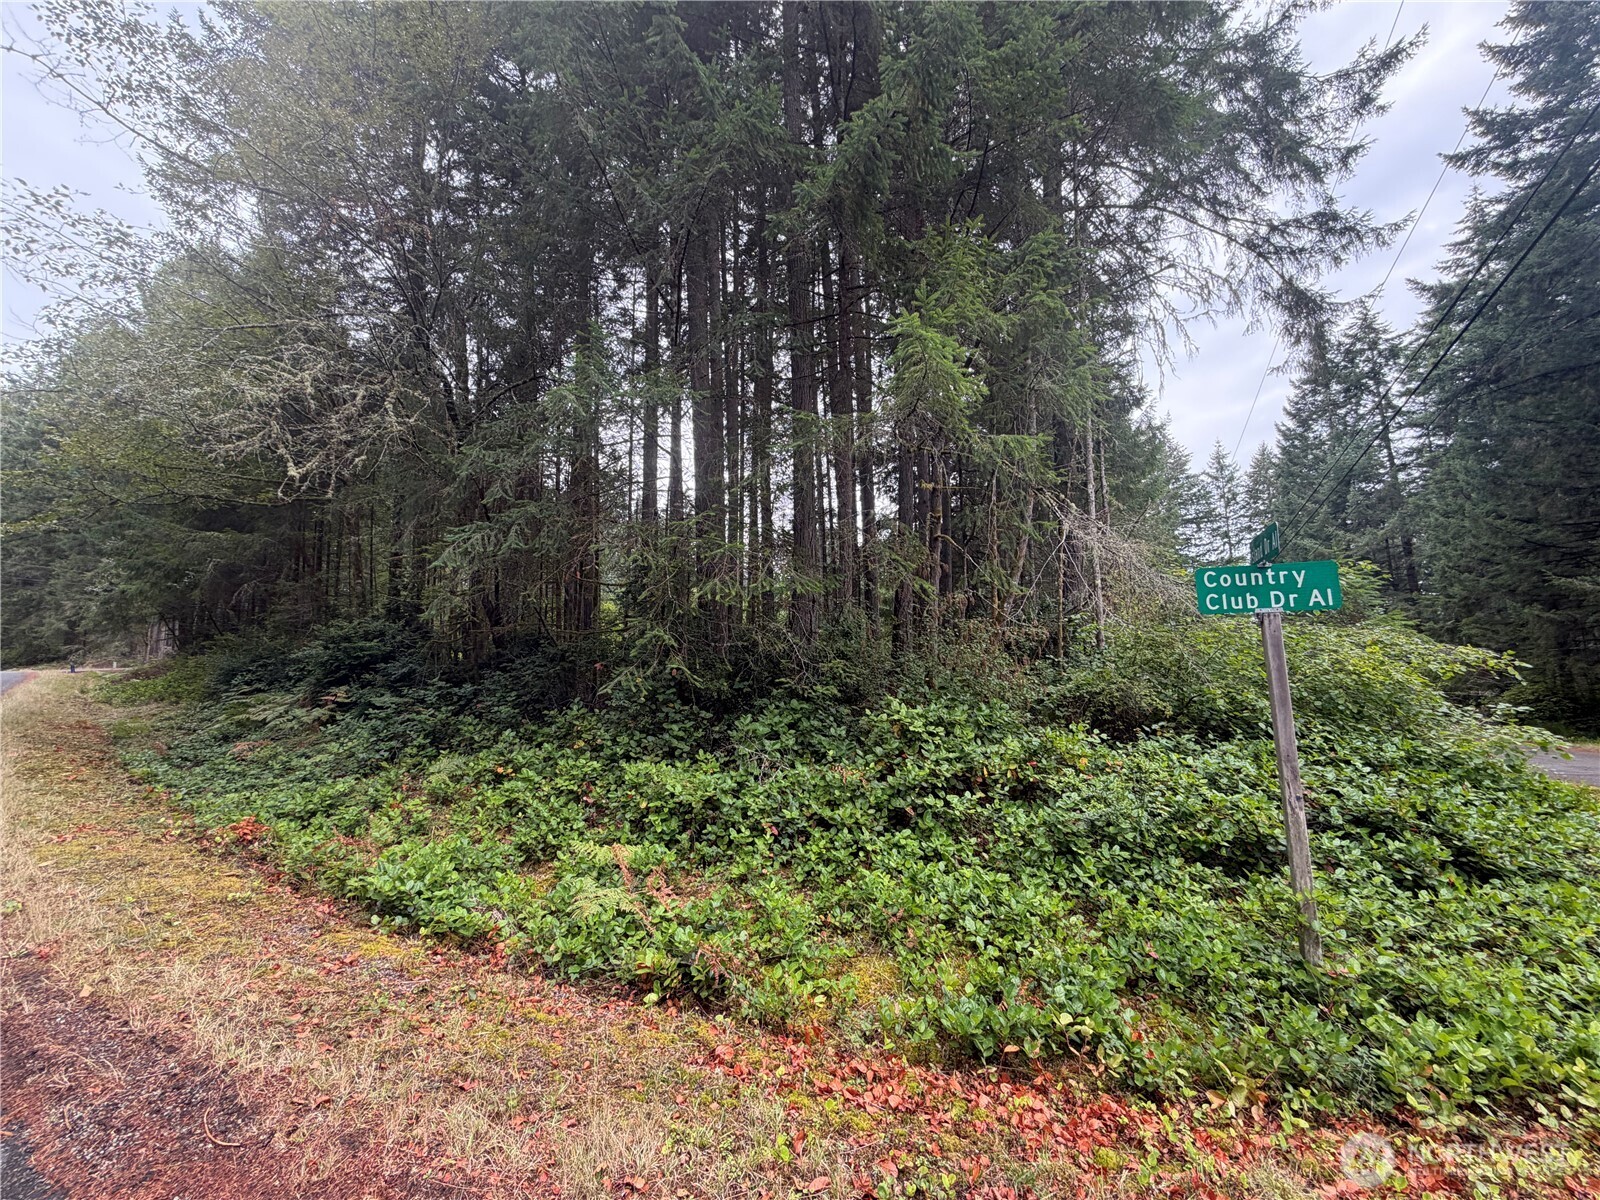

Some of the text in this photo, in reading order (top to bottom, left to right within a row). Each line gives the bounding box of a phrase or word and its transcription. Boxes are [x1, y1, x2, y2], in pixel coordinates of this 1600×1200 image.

[1203, 568, 1306, 588] Country
[1205, 592, 1259, 610] Club
[1269, 590, 1298, 608] Dr
